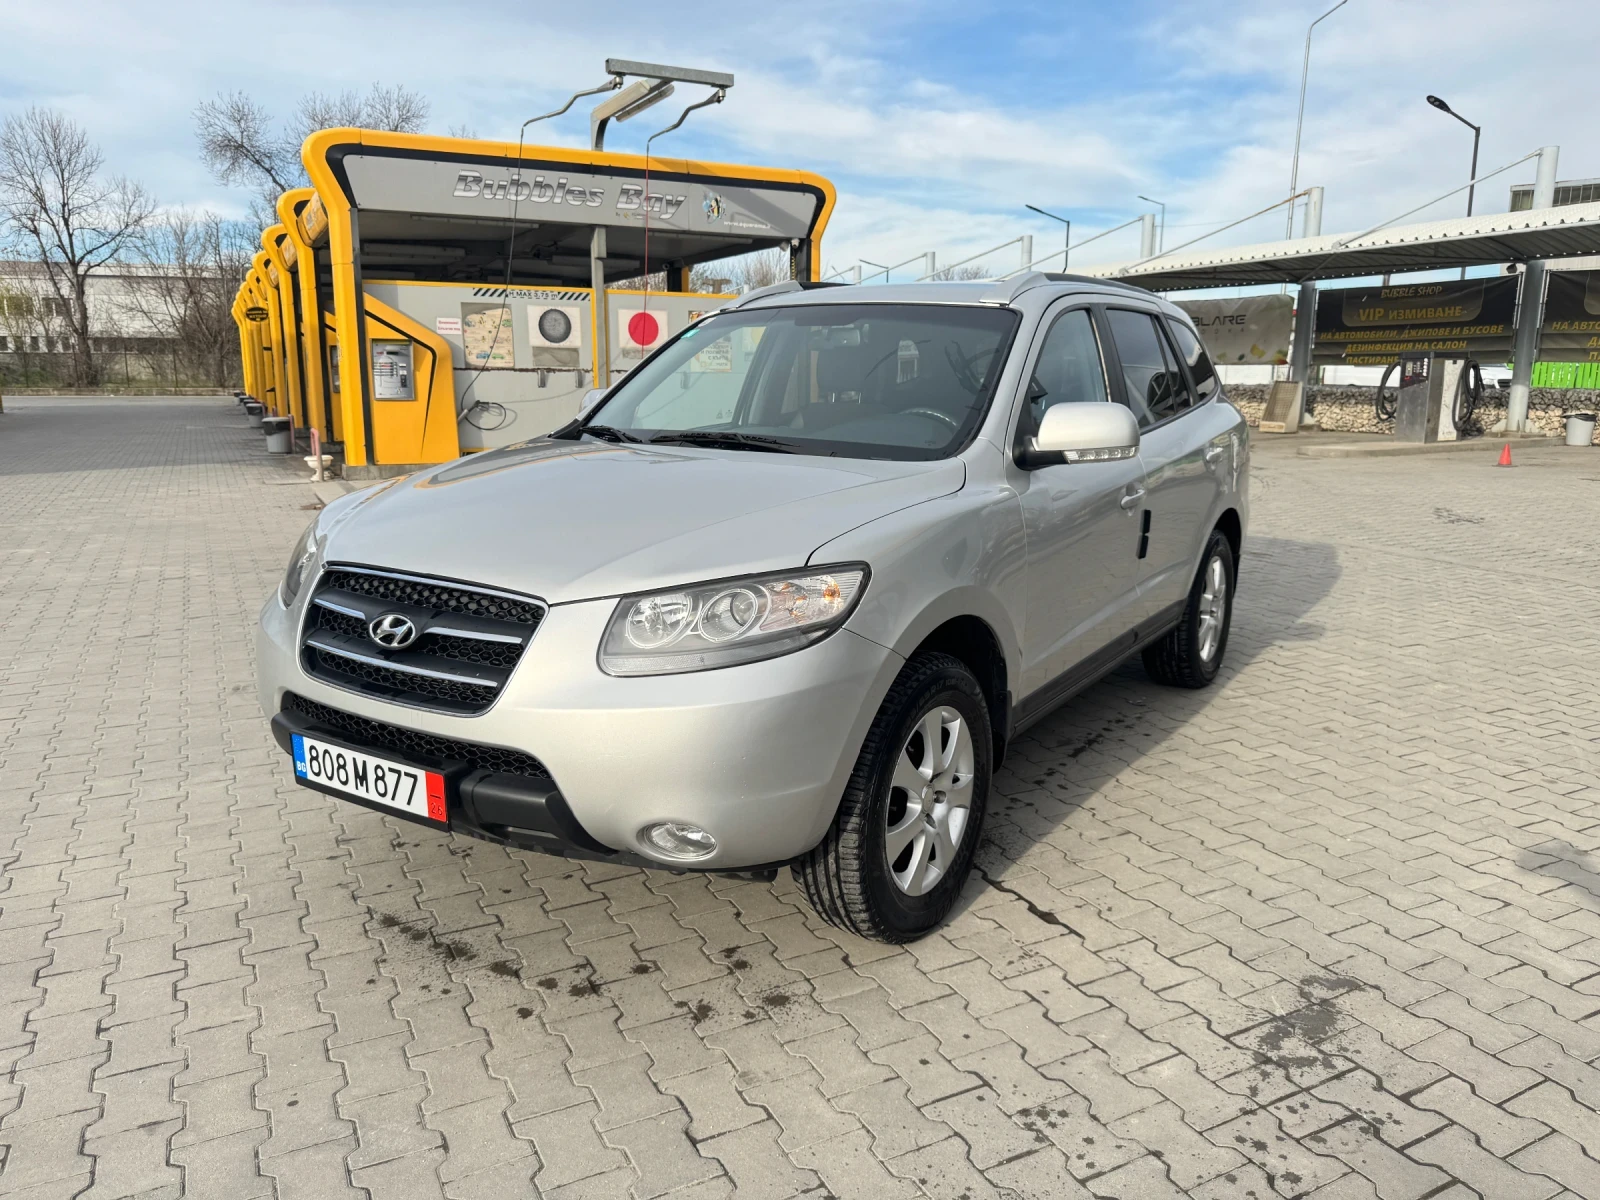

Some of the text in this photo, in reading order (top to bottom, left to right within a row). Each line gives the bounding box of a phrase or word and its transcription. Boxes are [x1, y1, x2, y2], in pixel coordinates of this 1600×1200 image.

[452, 169, 687, 220] Bubbles Bay
[1381, 286, 1442, 298] BUBBLE SHOP
[1359, 306, 1462, 321] VIP ИЗМИВАНЕ
[1401, 327, 1450, 338] ДЖИПОВЕ
[1452, 327, 1460, 335] И
[1463, 325, 1504, 335] БУСОВЕ
[1552, 321, 1568, 330] НА
[1345, 341, 1467, 353] ДЕЗИНФЕКЦИЯ НА САЛОН
[296, 761, 307, 773] BG
[308, 744, 418, 806] 808 M 877
[431, 802, 443, 815] 26
